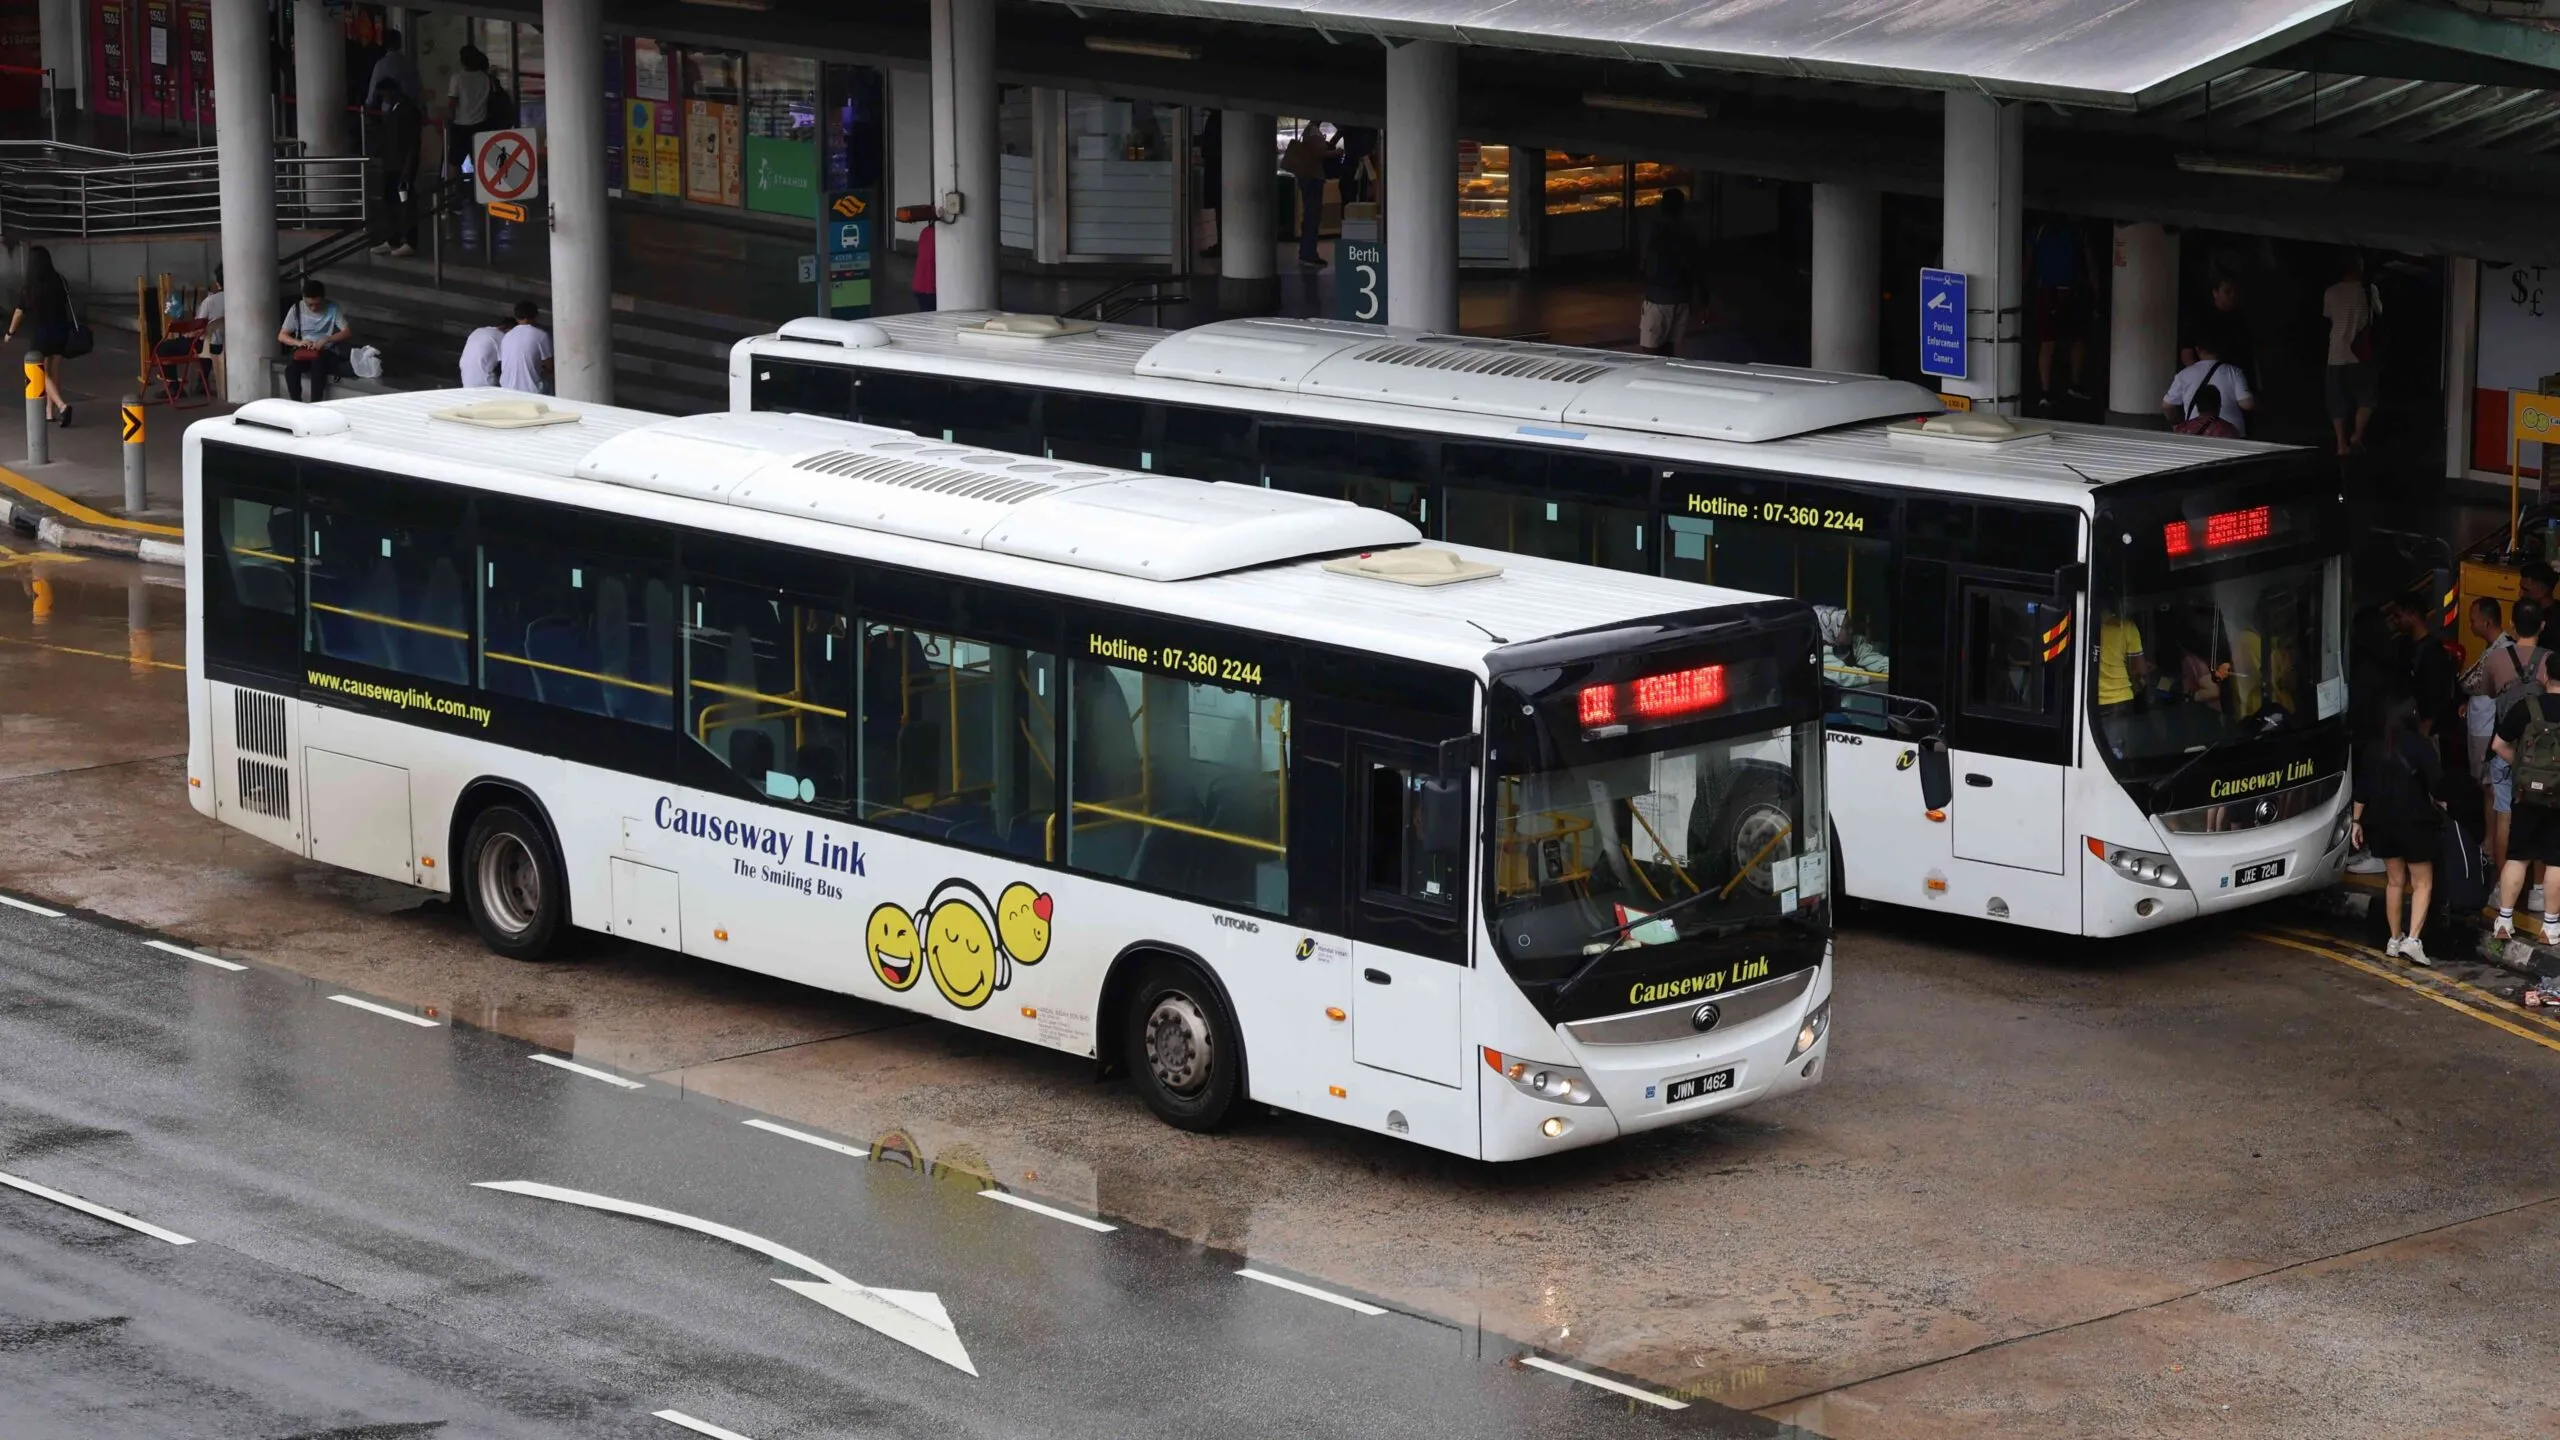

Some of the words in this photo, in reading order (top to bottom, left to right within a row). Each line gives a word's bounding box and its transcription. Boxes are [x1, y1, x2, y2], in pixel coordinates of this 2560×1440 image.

[1349, 246, 1379, 263] Berth
[803, 266, 811, 280] 3
[1355, 265, 1379, 320] 3
[1927, 335, 1960, 349] Enforcement
[1933, 321, 1954, 335] Parking
[1933, 352, 1954, 365] Camera
[1688, 493, 1748, 518] Hotline
[1763, 502, 1819, 526] 07-360
[1823, 509, 1864, 532] 2244
[1089, 633, 1148, 664] Hotline
[1162, 647, 1217, 677] 07-360
[1221, 658, 1262, 685] 2244
[307, 669, 491, 728] www.causewaylink.com.my
[2210, 769, 2284, 798] Causeway
[2286, 757, 2314, 781] Link
[654, 795, 794, 865] Causeway
[804, 830, 866, 878] Link
[733, 857, 757, 879] The
[761, 864, 812, 896] Smiling
[816, 878, 843, 900] Bus
[2241, 868, 2257, 884] JXE
[2261, 862, 2278, 880] 7241
[1212, 913, 1260, 934] YUTONG
[1629, 969, 1727, 1005] Causeway
[1731, 955, 1769, 984] Link
[1673, 1081, 1695, 1100] JWN
[1703, 1073, 1727, 1092] 1462
